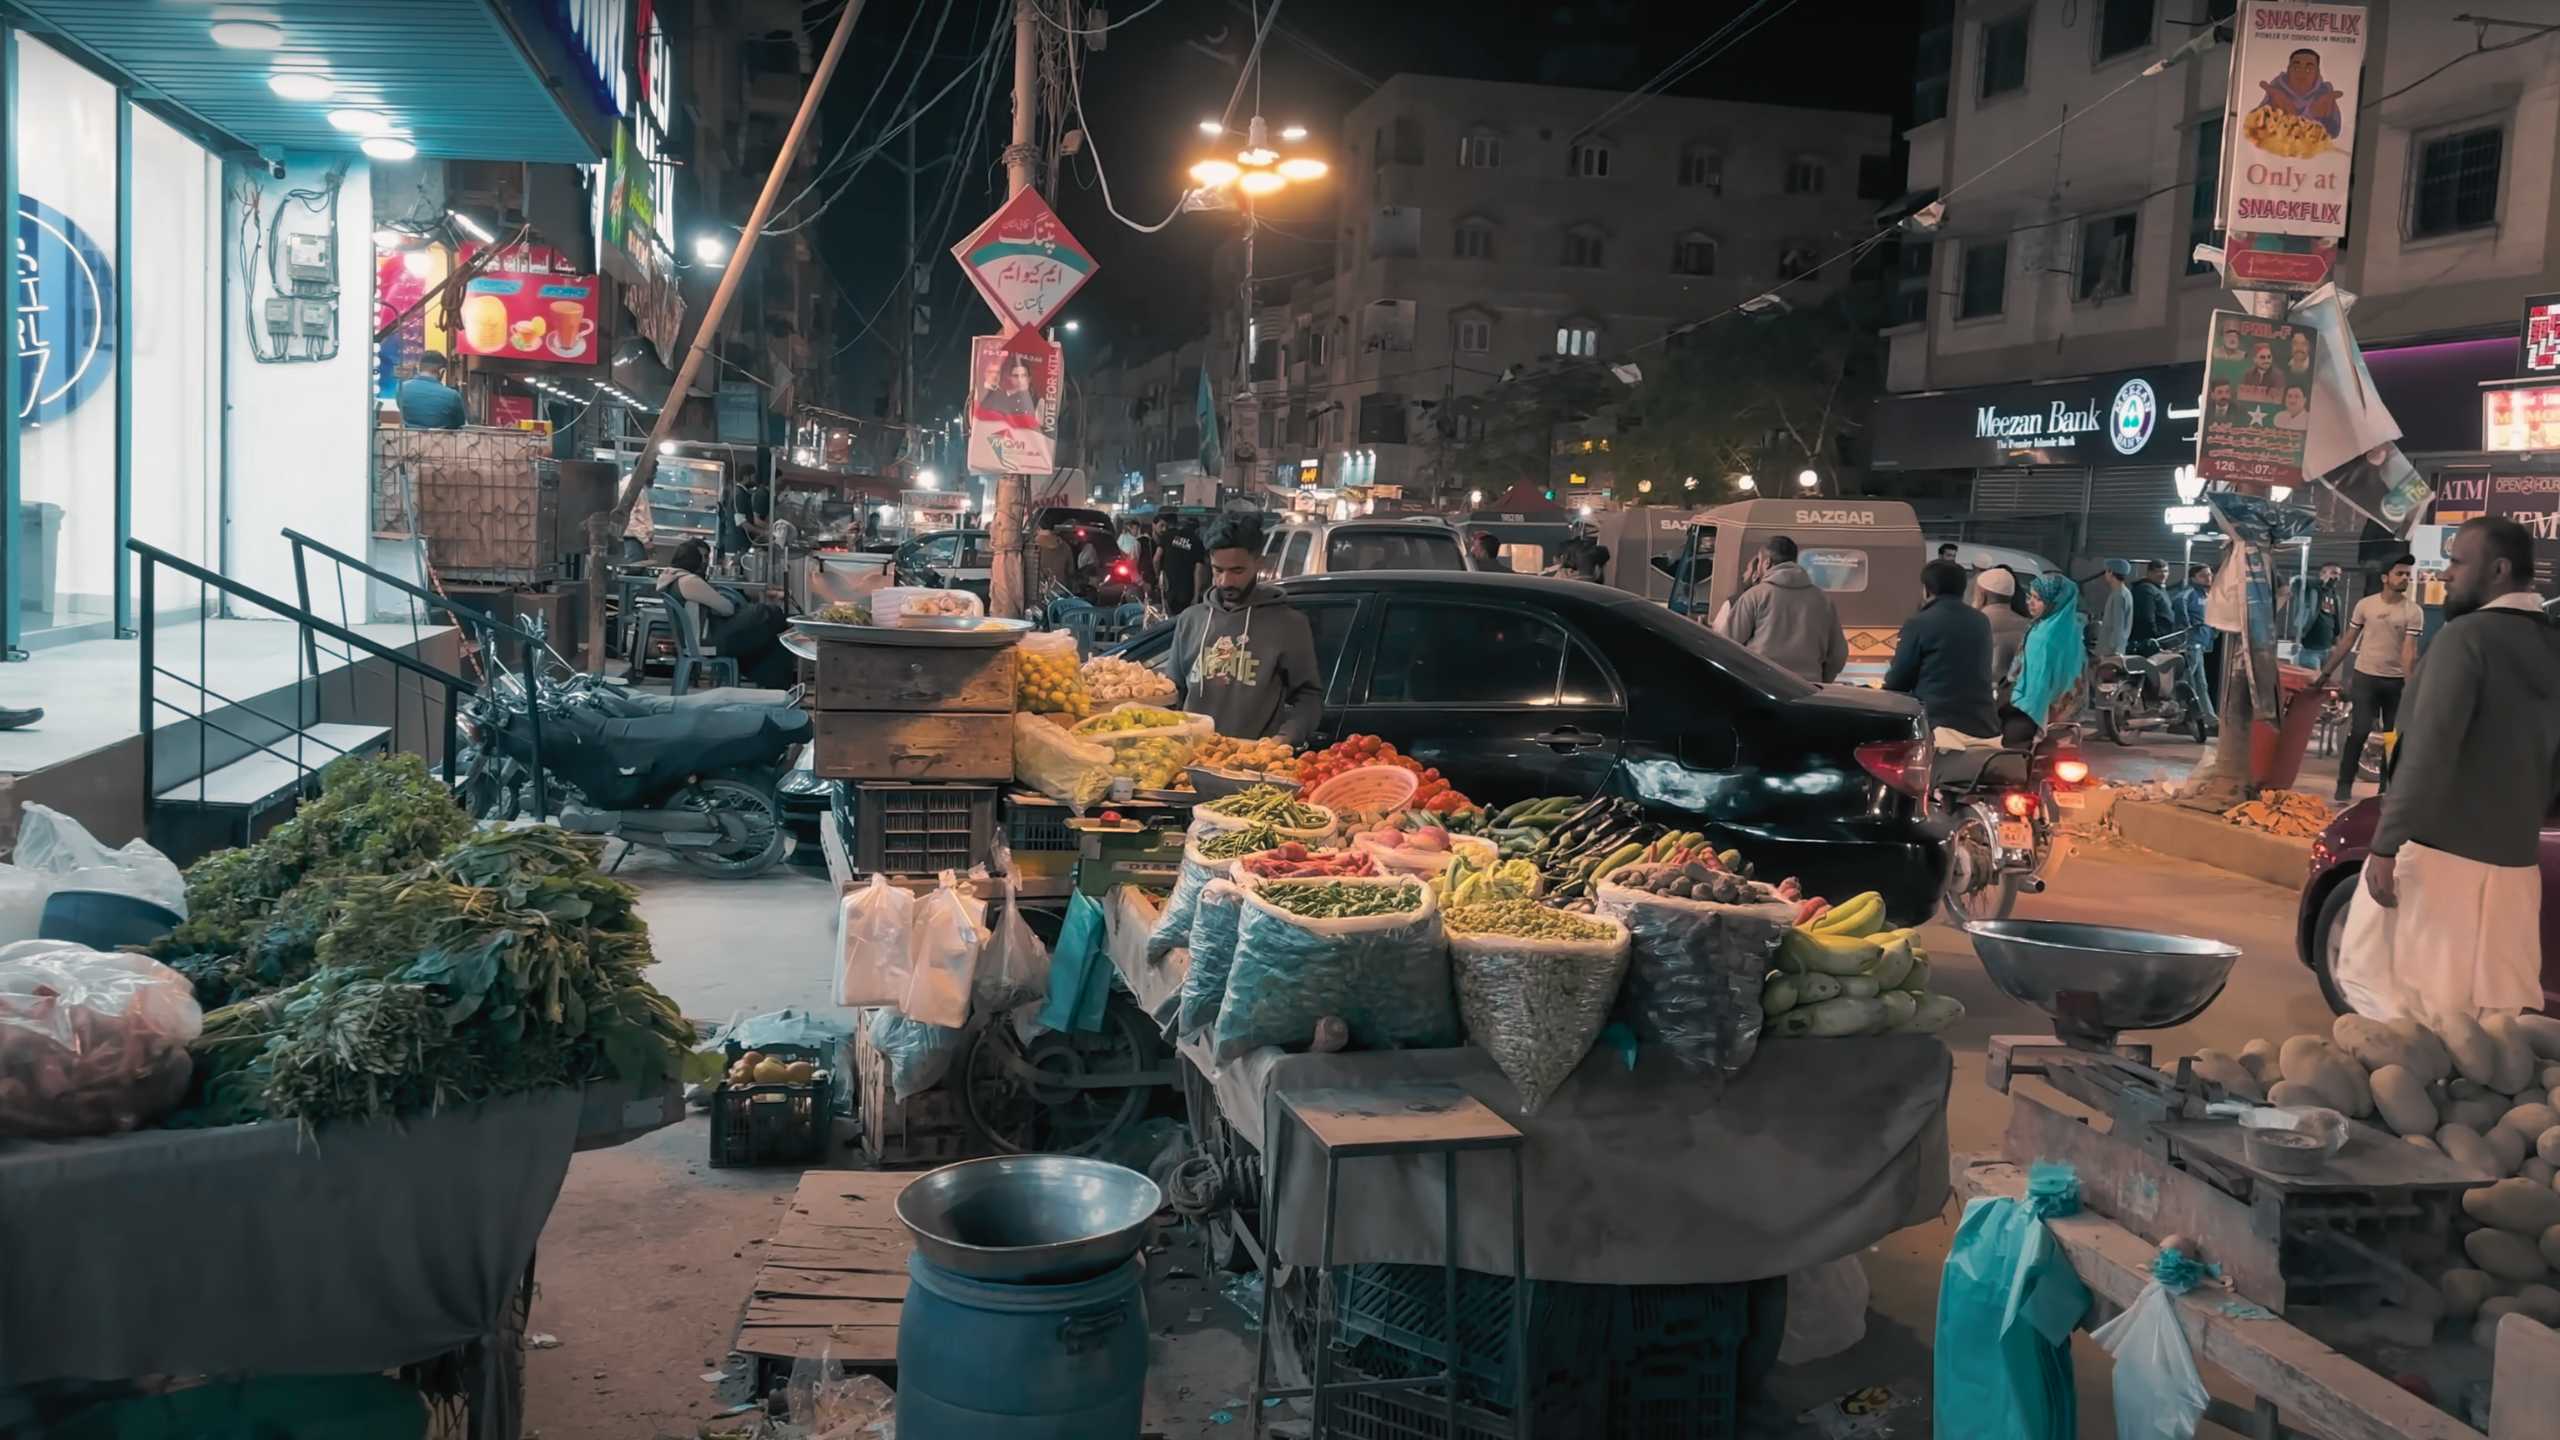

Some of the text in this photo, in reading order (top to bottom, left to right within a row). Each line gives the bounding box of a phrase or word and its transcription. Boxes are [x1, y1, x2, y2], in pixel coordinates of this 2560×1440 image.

[2255, 9, 2361, 35] SNACKFLIX
[2246, 163, 2337, 192] Only at
[2238, 198, 2342, 224] SNACKFLIX
[1046, 377, 1057, 401] FOR
[2114, 384, 2152, 414] MEEZAN
[1045, 402, 1057, 433] VOTE
[1975, 398, 2101, 438] Meezan Bank
[1996, 439, 2008, 450] The
[2058, 435, 2076, 447] Bank
[2116, 432, 2142, 449] BANK
[2441, 479, 2484, 501] ATM
[2496, 480, 2521, 491] OPEN
[1796, 510, 1874, 525] SAZGAR
[2502, 511, 2559, 540] TM
